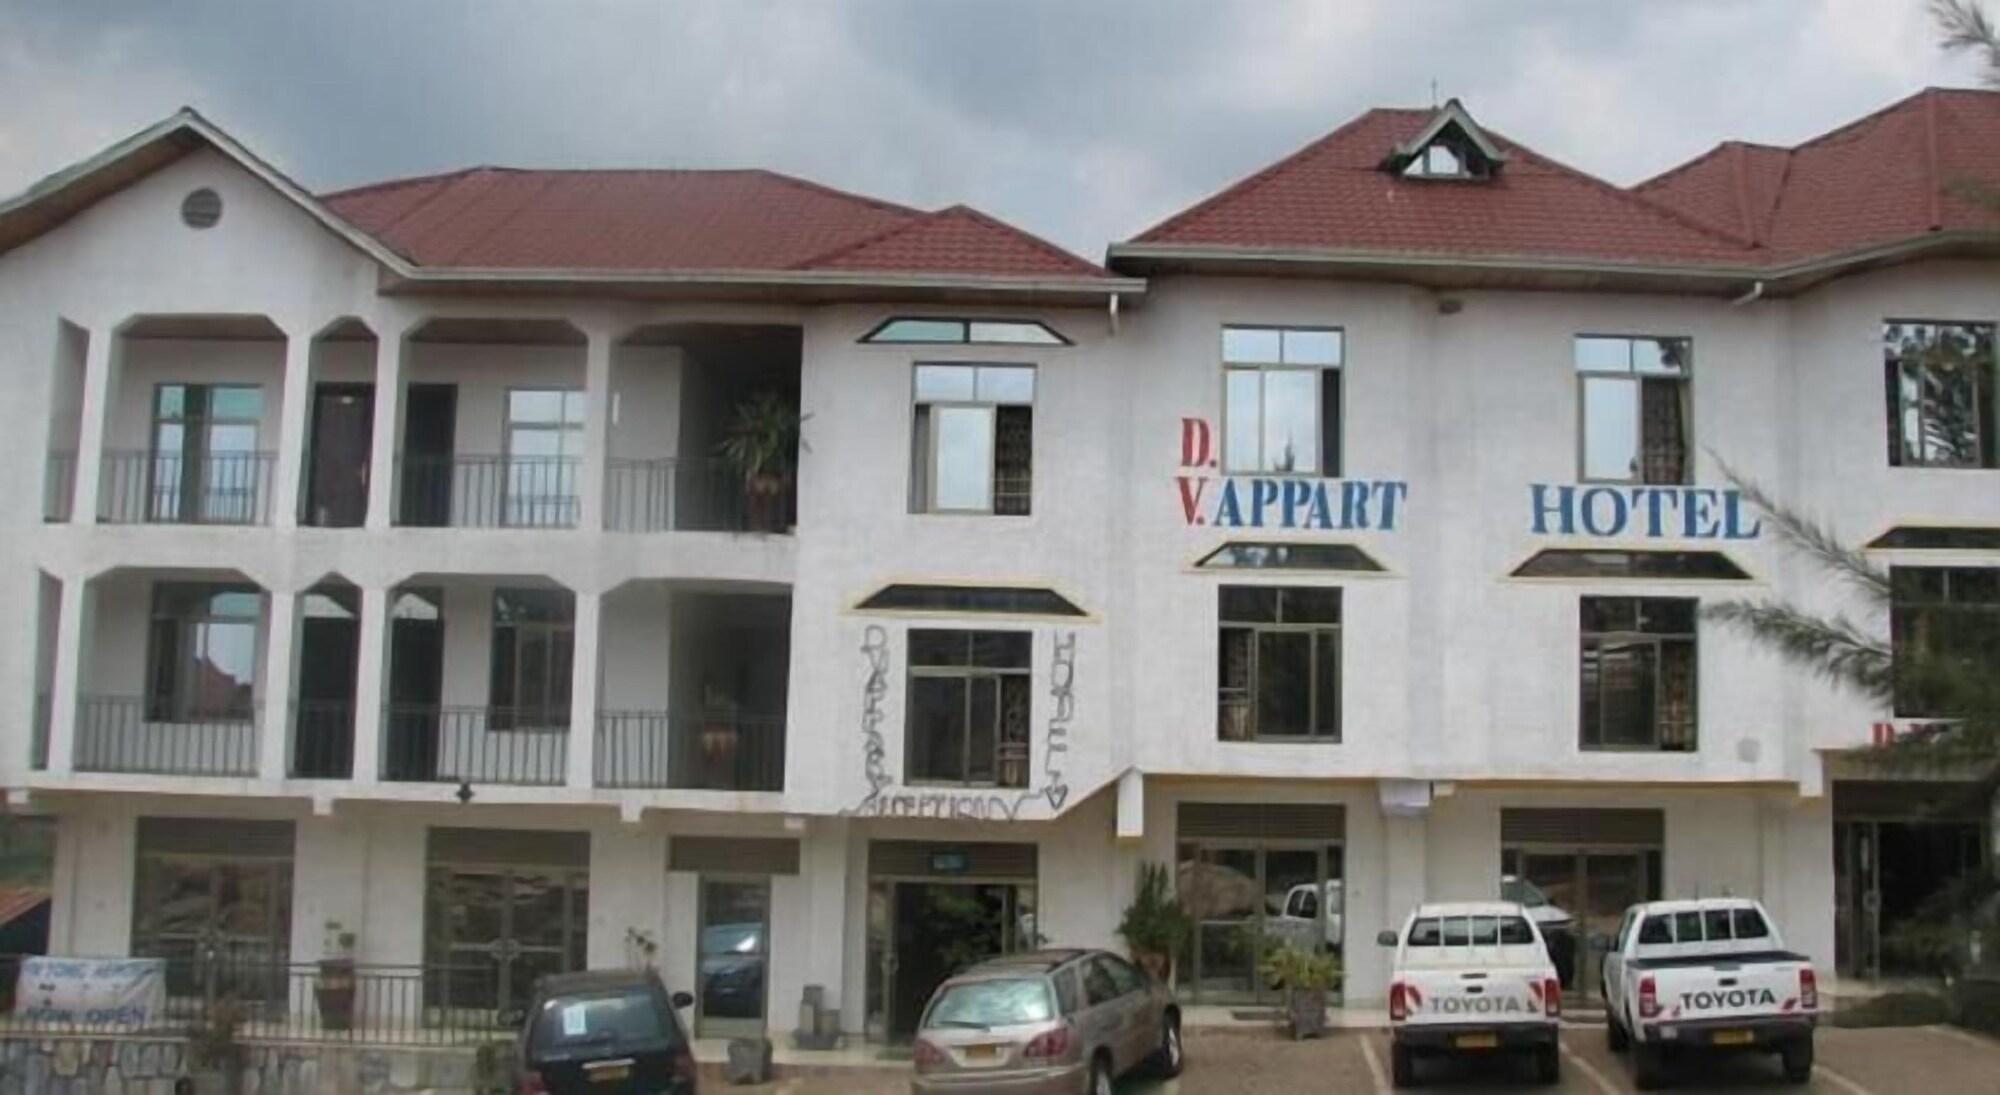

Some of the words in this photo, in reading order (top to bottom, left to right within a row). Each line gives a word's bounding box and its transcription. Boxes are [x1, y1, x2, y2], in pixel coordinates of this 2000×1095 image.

[1530, 483, 1760, 540] HOTEL
[1430, 997, 1520, 1013] TOYOTA
[1679, 988, 1776, 1009] TOYOTA
